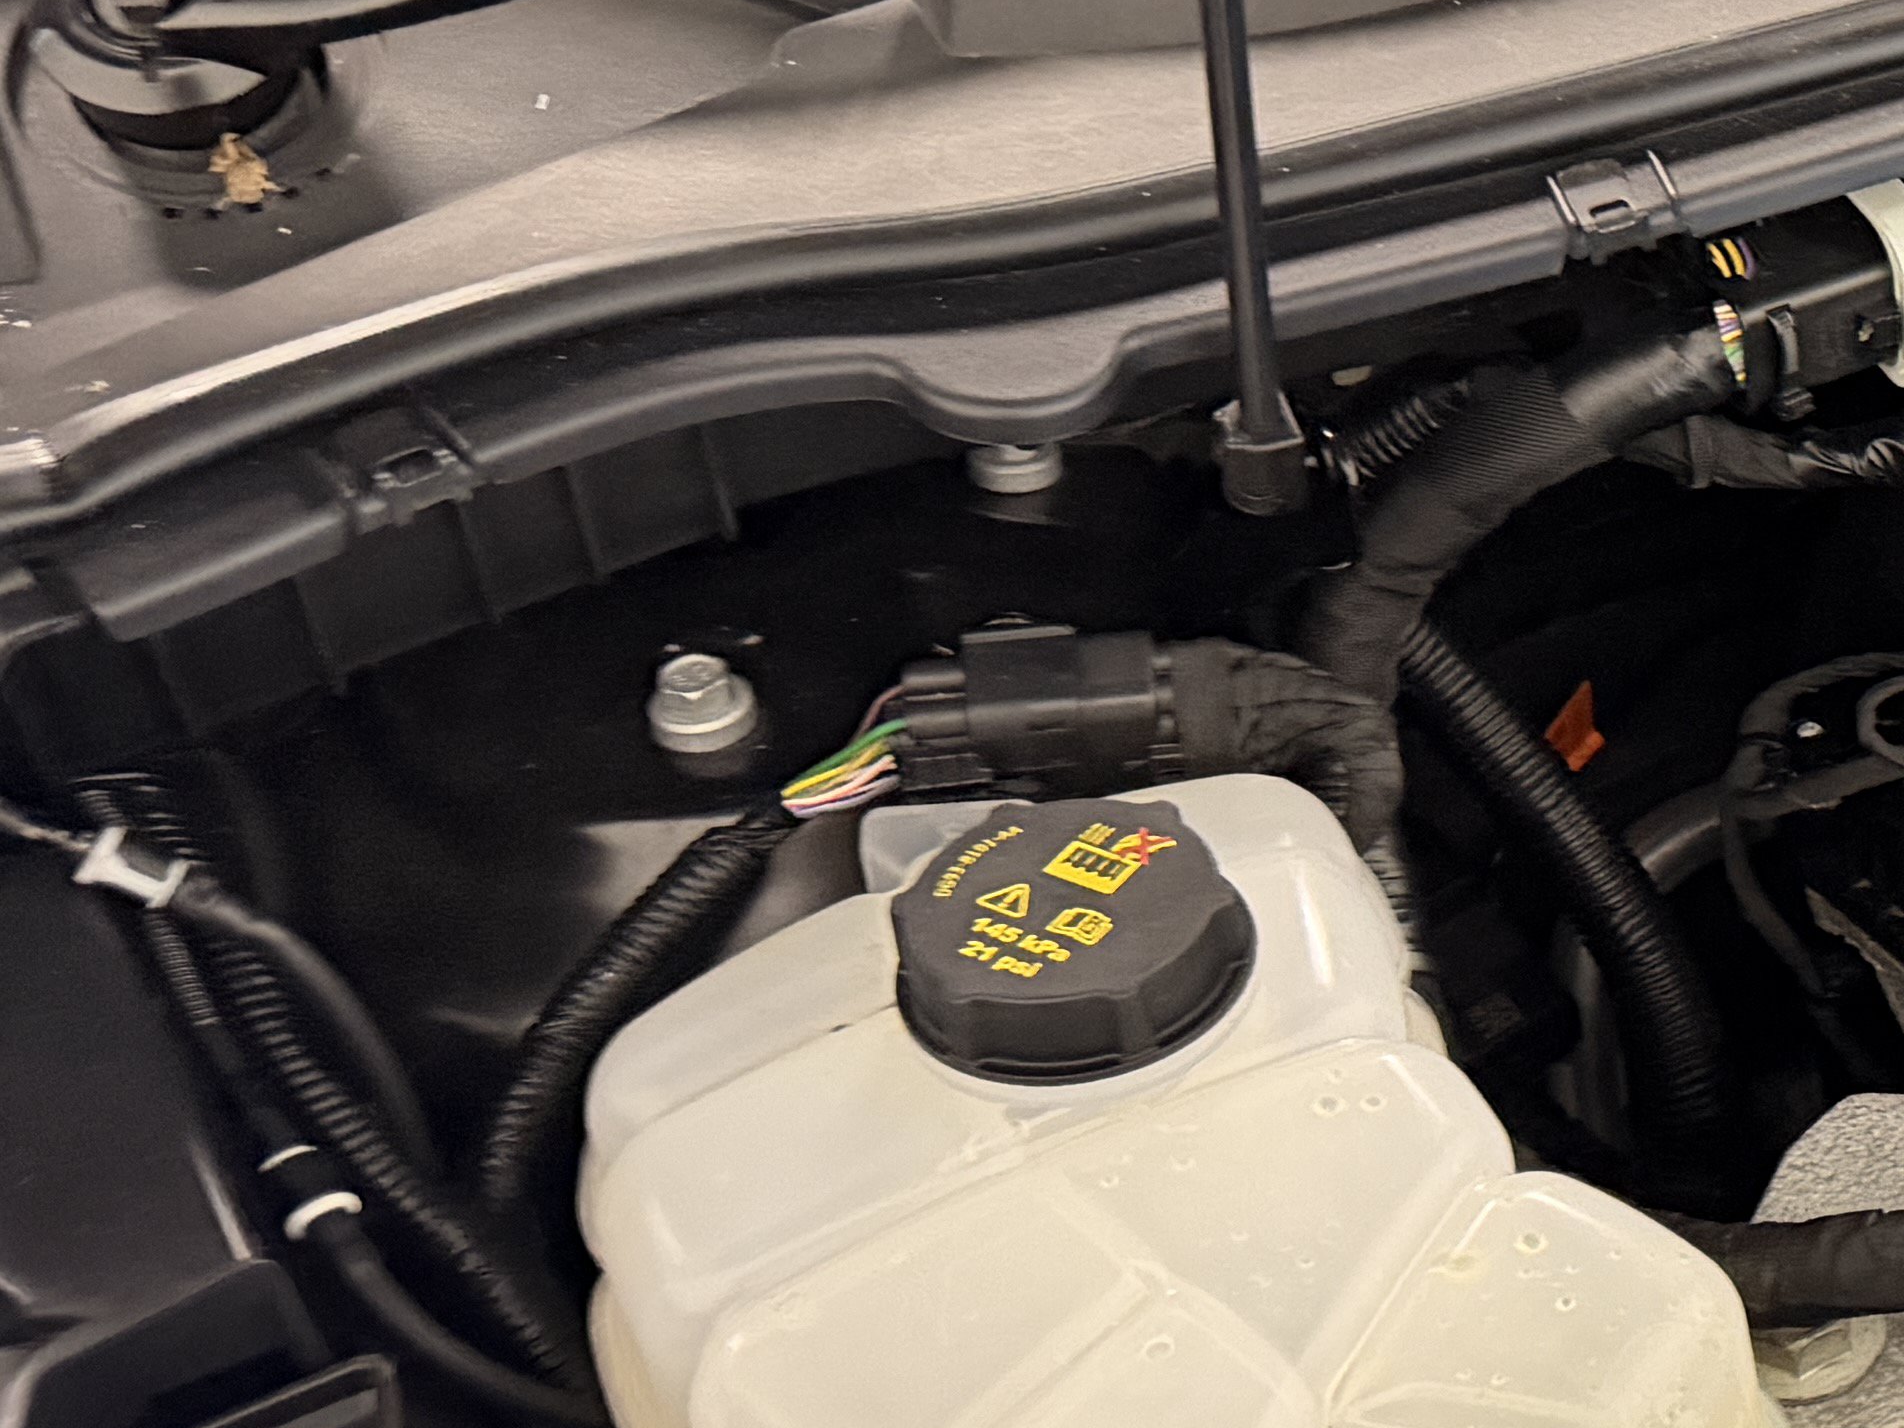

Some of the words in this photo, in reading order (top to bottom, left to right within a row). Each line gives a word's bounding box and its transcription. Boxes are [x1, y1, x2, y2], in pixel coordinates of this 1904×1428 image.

[958, 940, 1000, 962] 21
[970, 917, 1025, 944] 145
[1017, 934, 1072, 963] kPa
